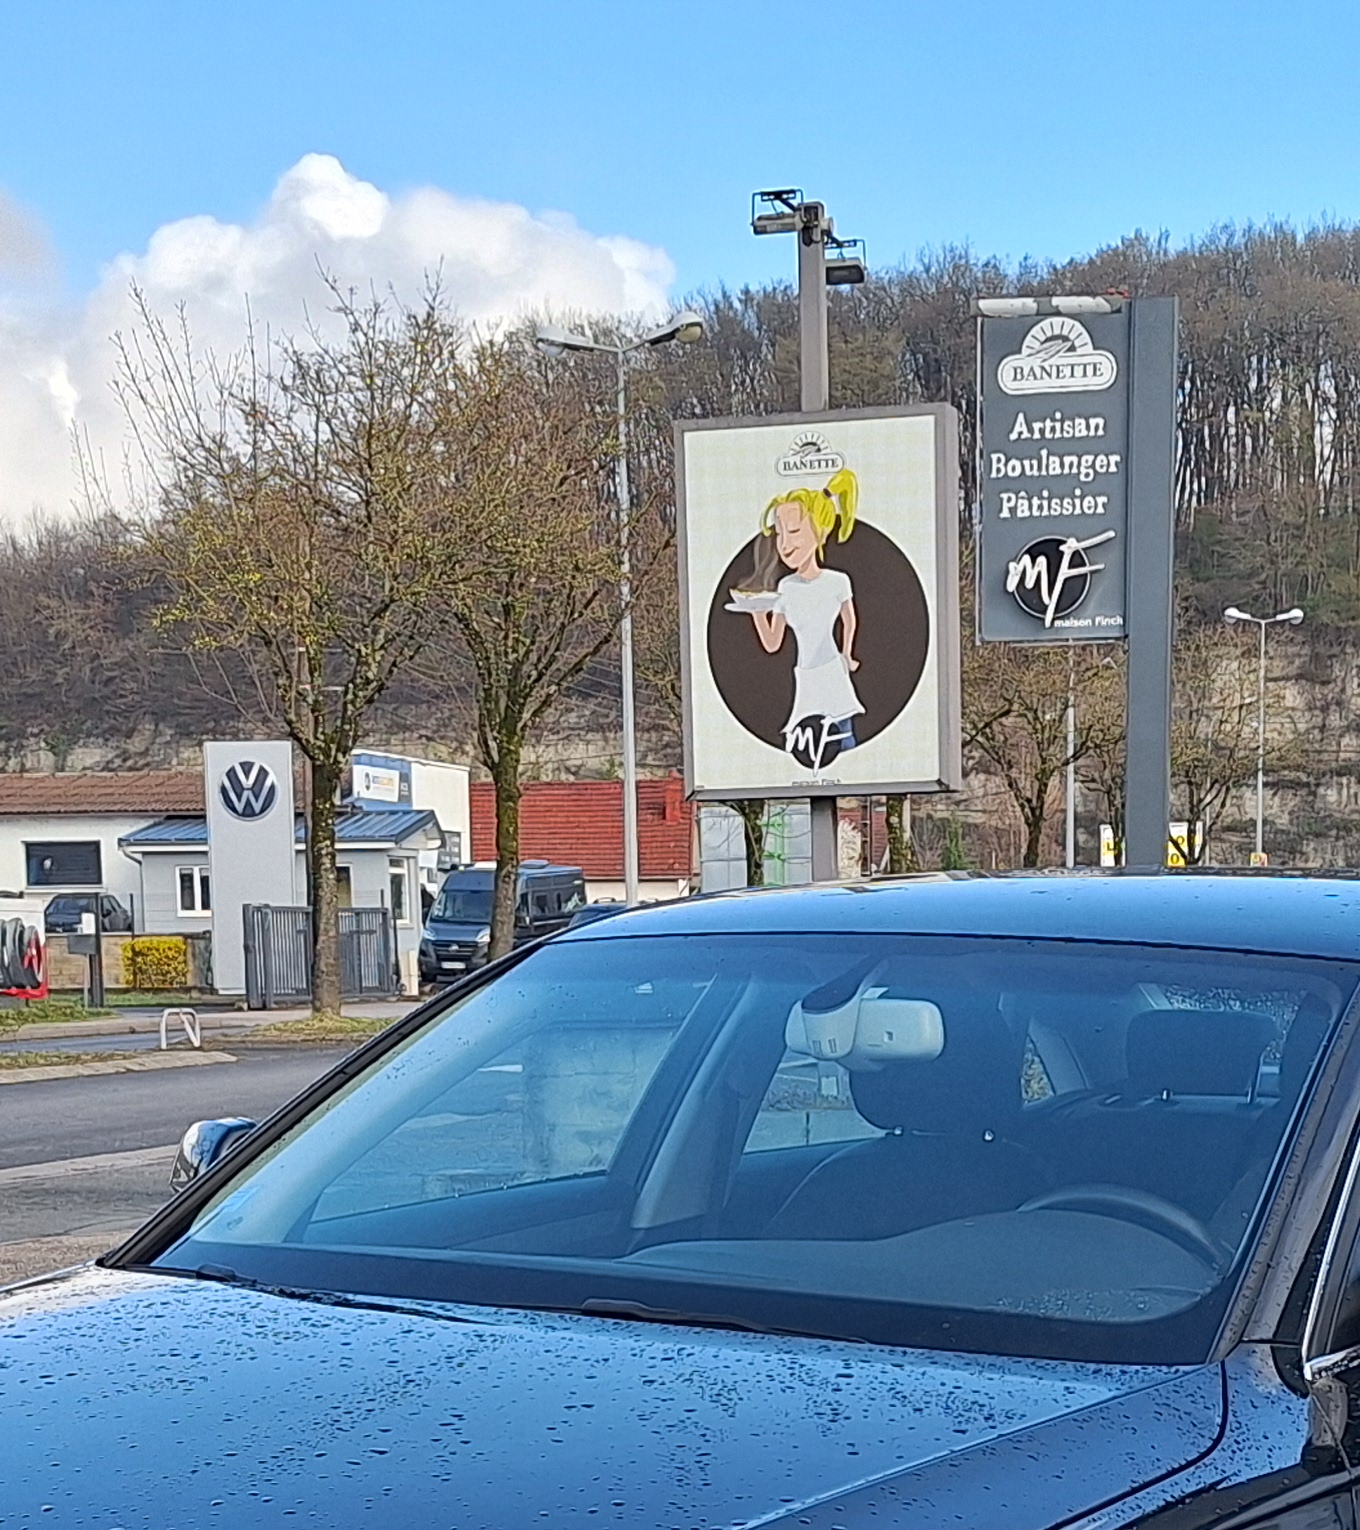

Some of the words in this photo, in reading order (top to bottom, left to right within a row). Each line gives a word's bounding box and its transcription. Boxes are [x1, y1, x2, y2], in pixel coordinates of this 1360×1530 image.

[1012, 362, 1105, 382] BANETTE
[1009, 411, 1106, 441] Artisan
[783, 458, 840, 471] BANETTE
[990, 448, 1121, 482] Boulanger
[999, 488, 1109, 519] Pâtissier
[1054, 617, 1093, 628] maison
